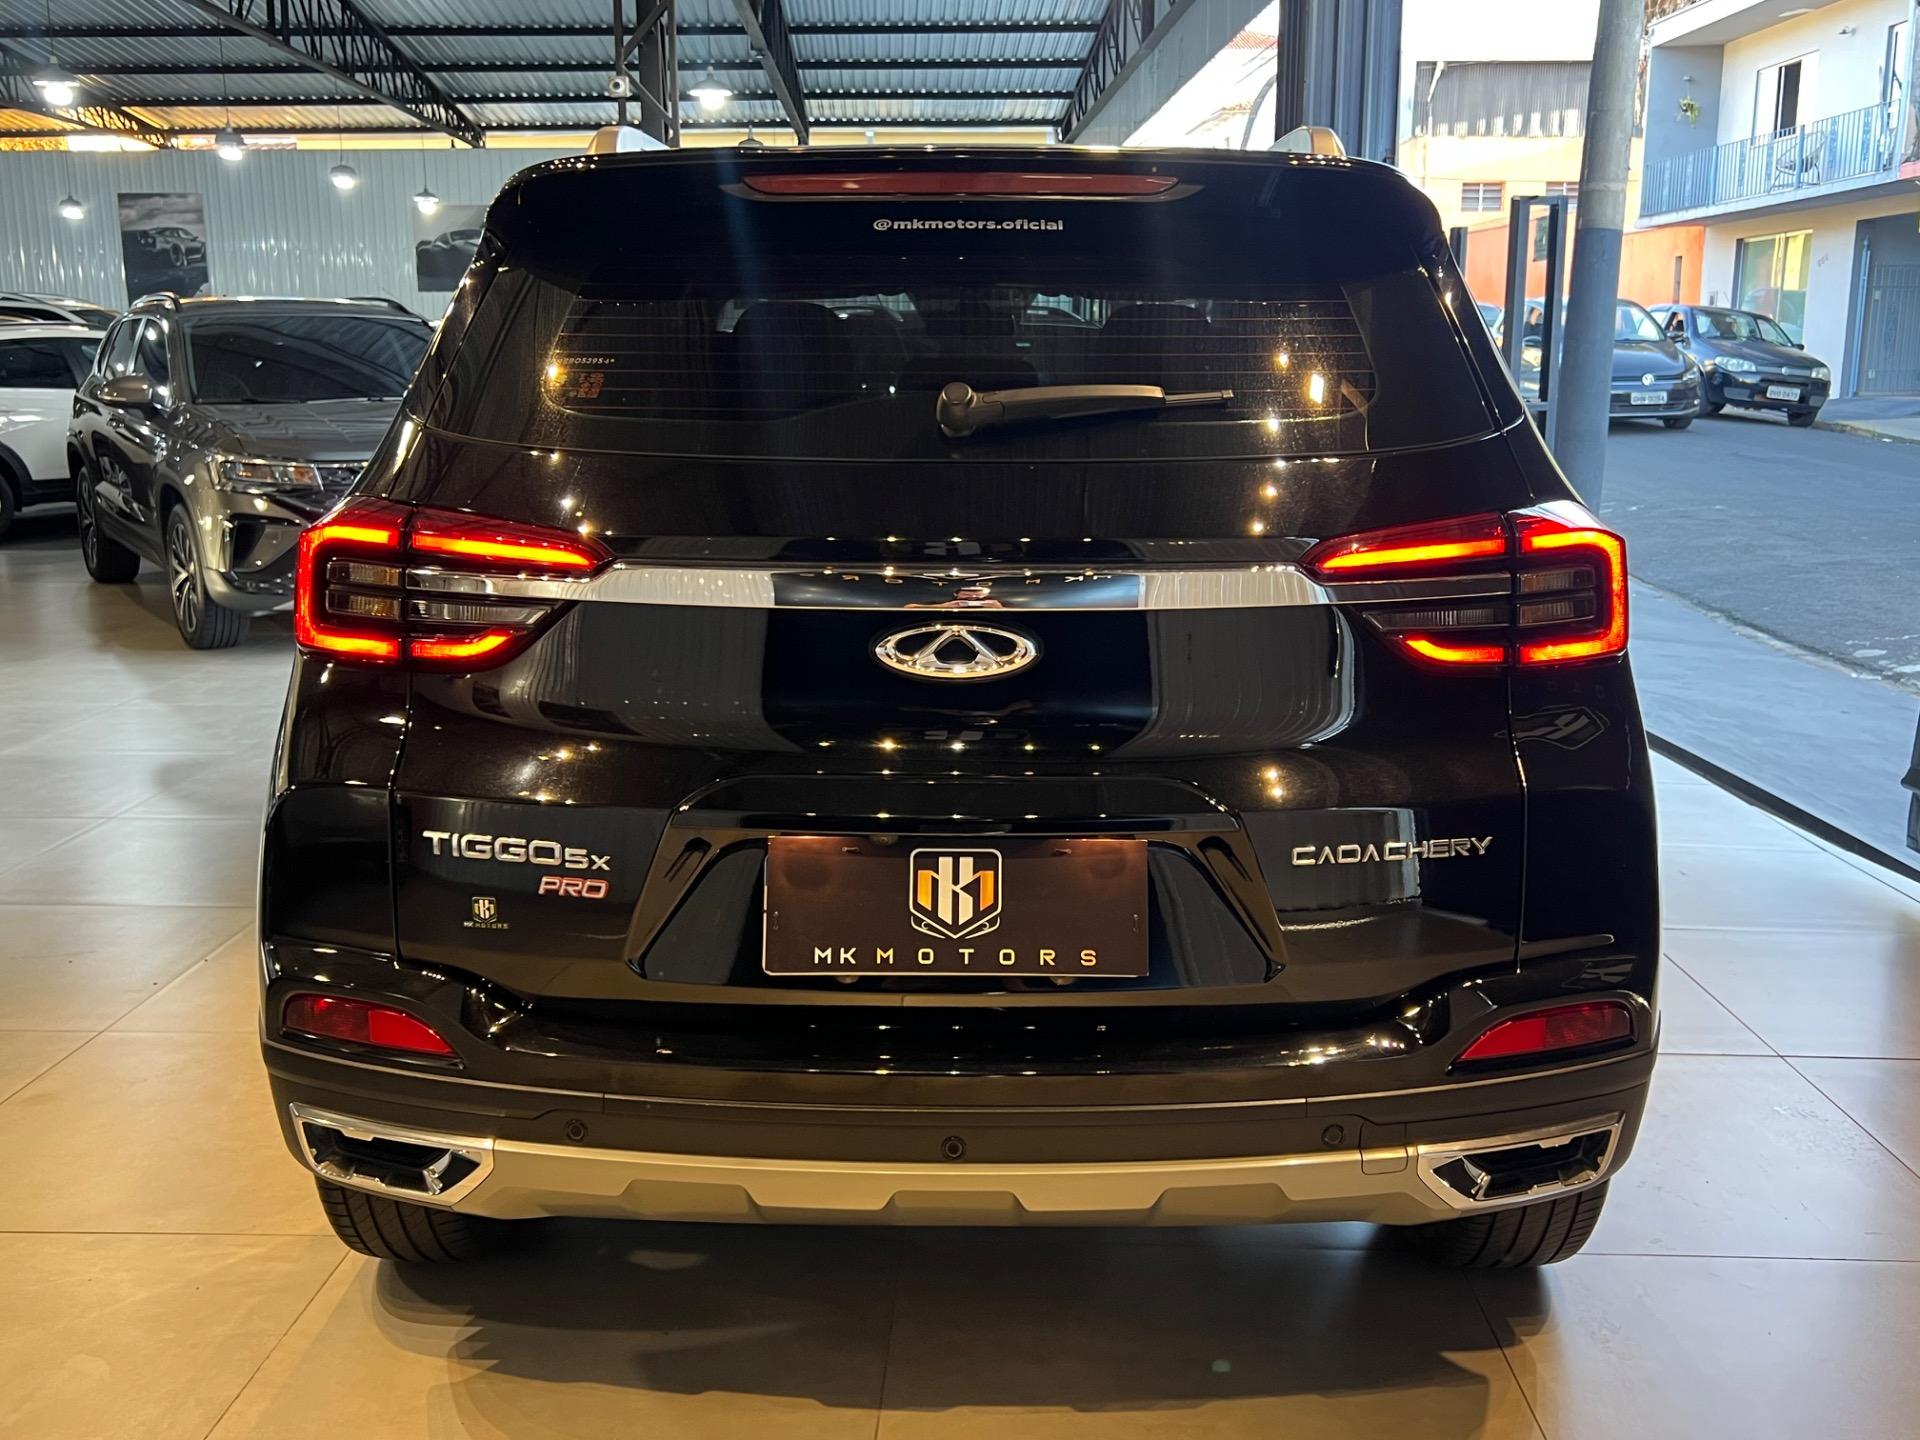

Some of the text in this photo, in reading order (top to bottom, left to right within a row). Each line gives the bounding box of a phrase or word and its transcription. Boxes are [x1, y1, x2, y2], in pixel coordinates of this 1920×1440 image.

[873, 218, 1064, 231] @mkmotors.oficial
[538, 875, 609, 899] PRO
[813, 946, 1097, 966] MK MOTORS
